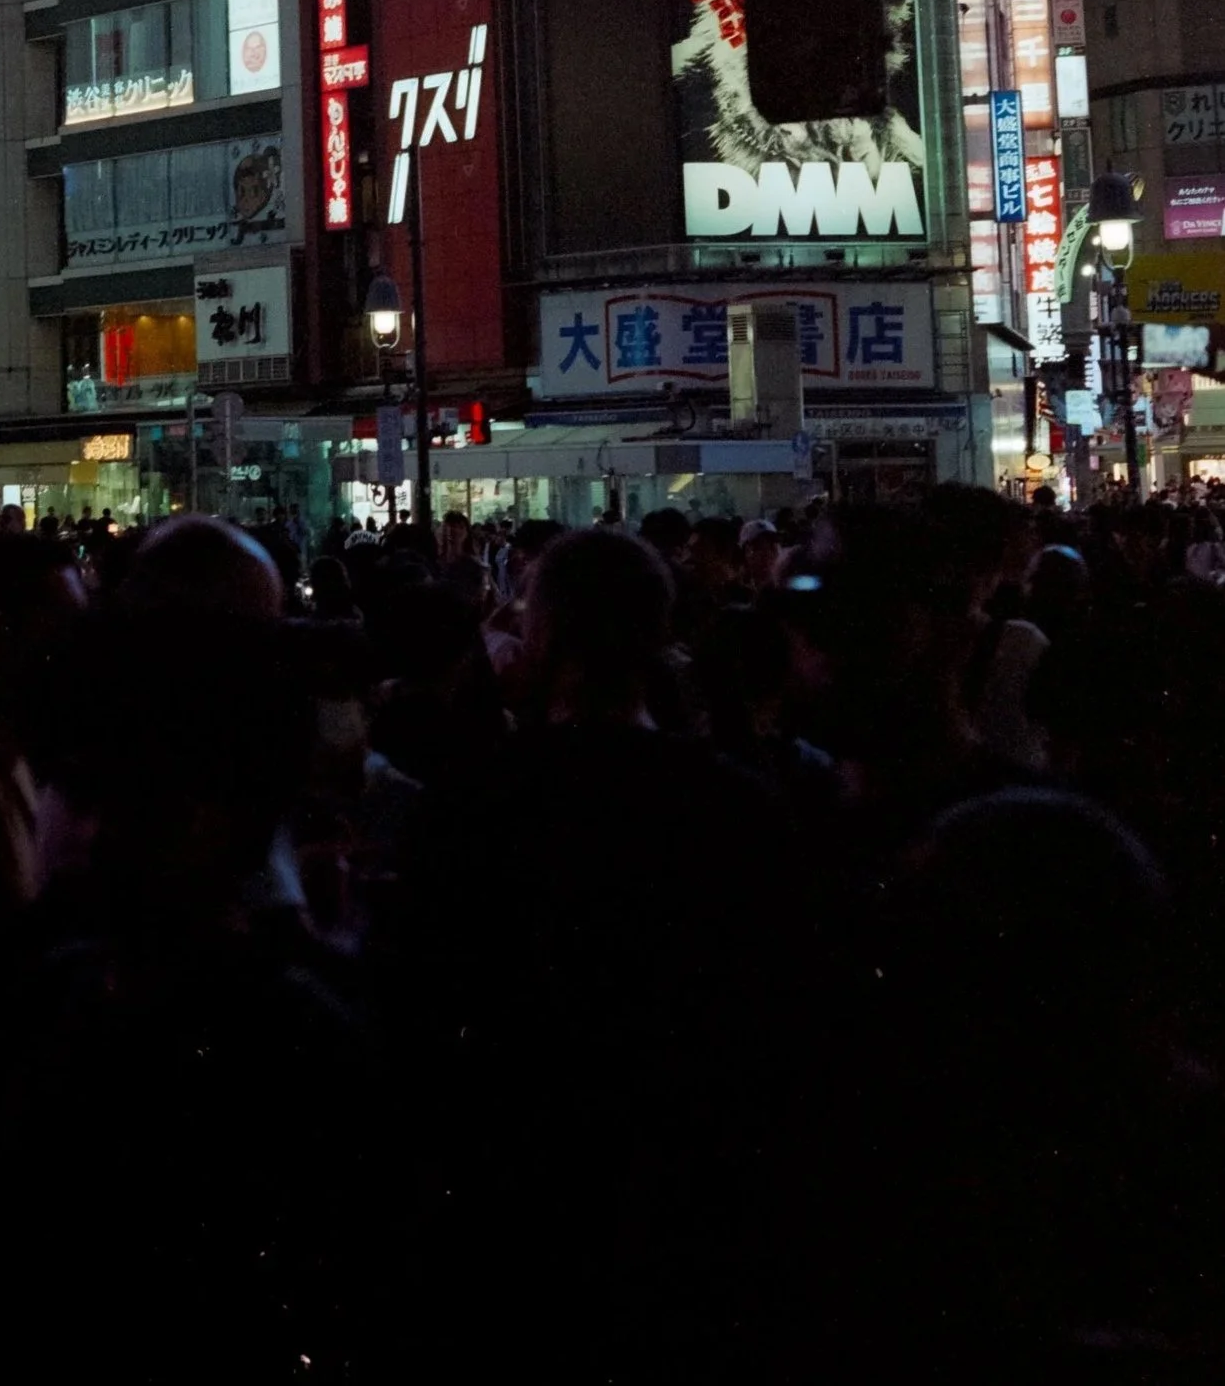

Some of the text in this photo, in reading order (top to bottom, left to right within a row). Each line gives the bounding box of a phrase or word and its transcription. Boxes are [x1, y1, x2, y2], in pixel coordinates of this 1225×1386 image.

[683, 162, 925, 236] DMM
[995, 98, 1022, 216] 大盛堂商事ビル
